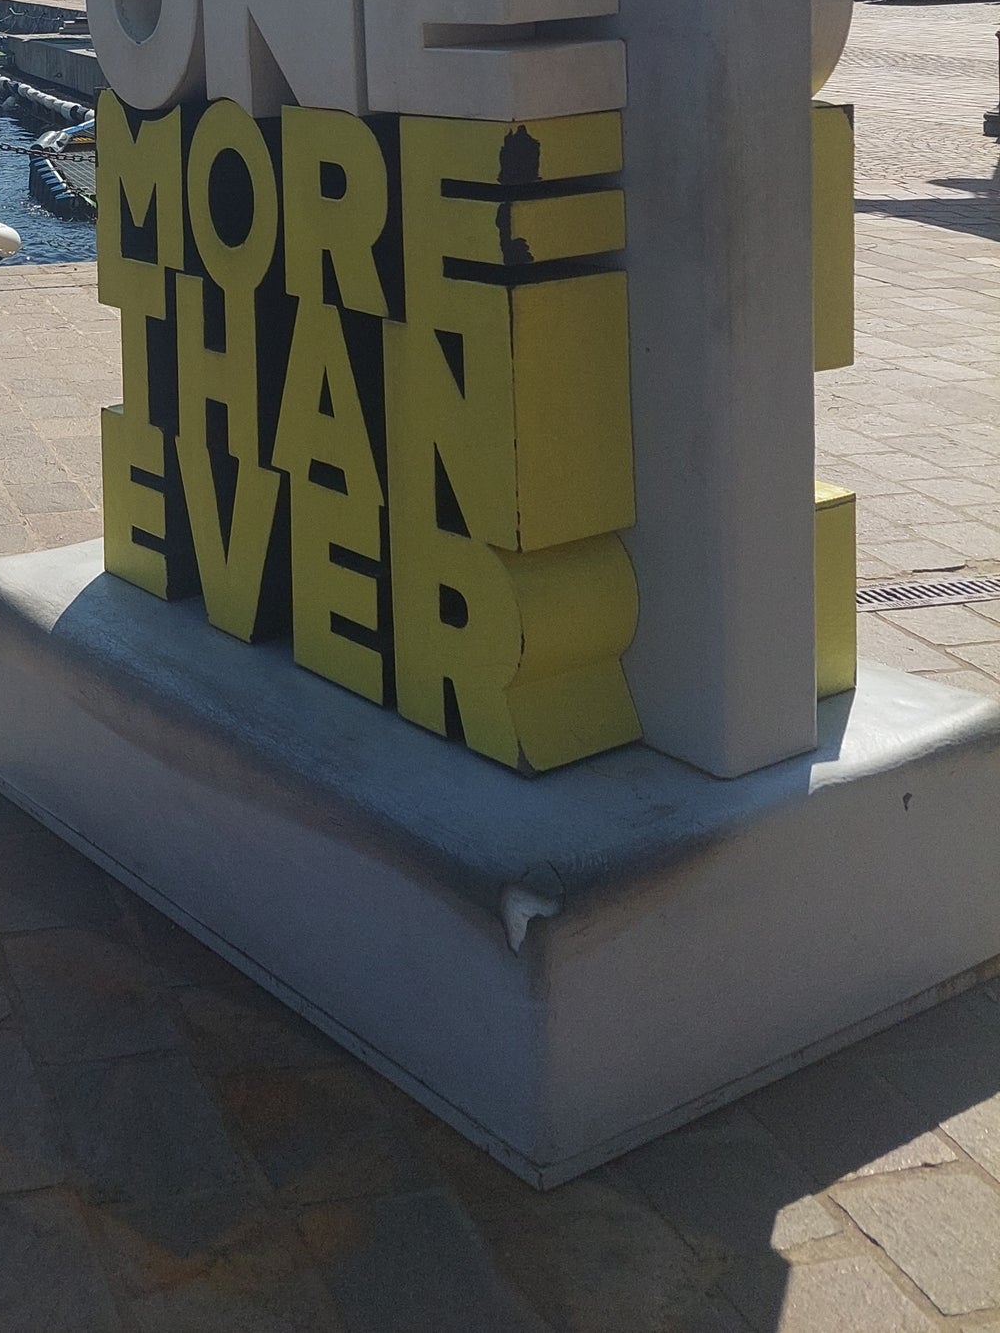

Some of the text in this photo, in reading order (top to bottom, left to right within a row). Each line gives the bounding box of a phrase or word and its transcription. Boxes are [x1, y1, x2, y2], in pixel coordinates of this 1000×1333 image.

[97, 88, 510, 322] MORE
[98, 266, 521, 552] THAN
[101, 407, 528, 778] EVER
